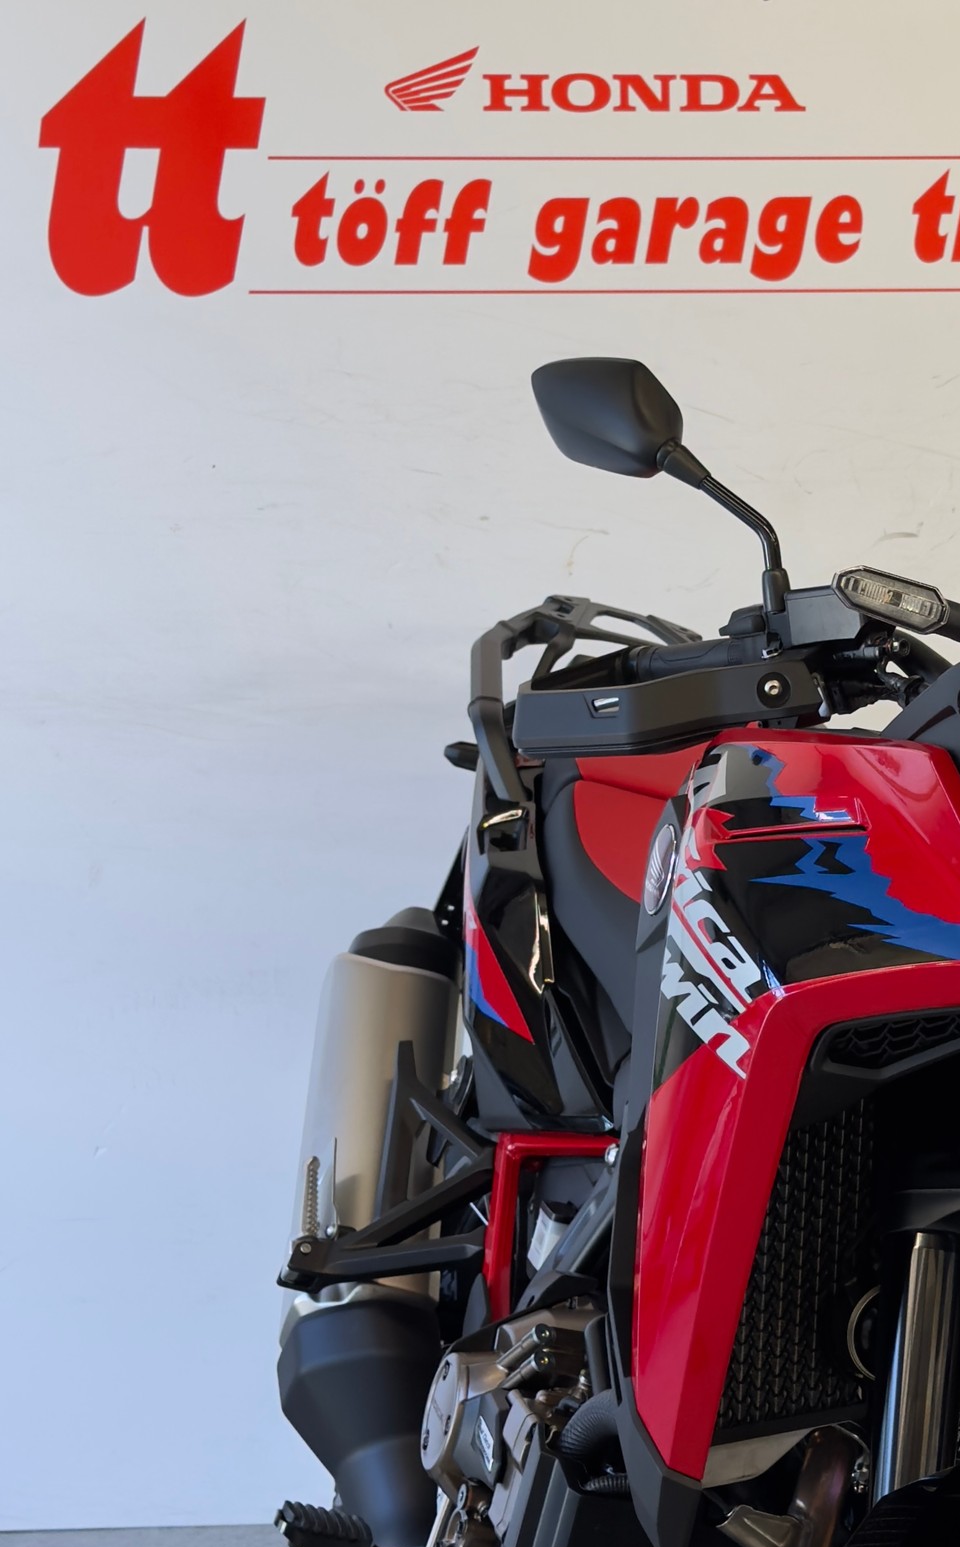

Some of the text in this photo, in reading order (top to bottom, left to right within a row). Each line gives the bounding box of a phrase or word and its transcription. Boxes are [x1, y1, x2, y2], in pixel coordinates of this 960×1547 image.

[483, 73, 806, 113] HONDA
[291, 171, 492, 267] töff
[528, 194, 863, 283] garage
